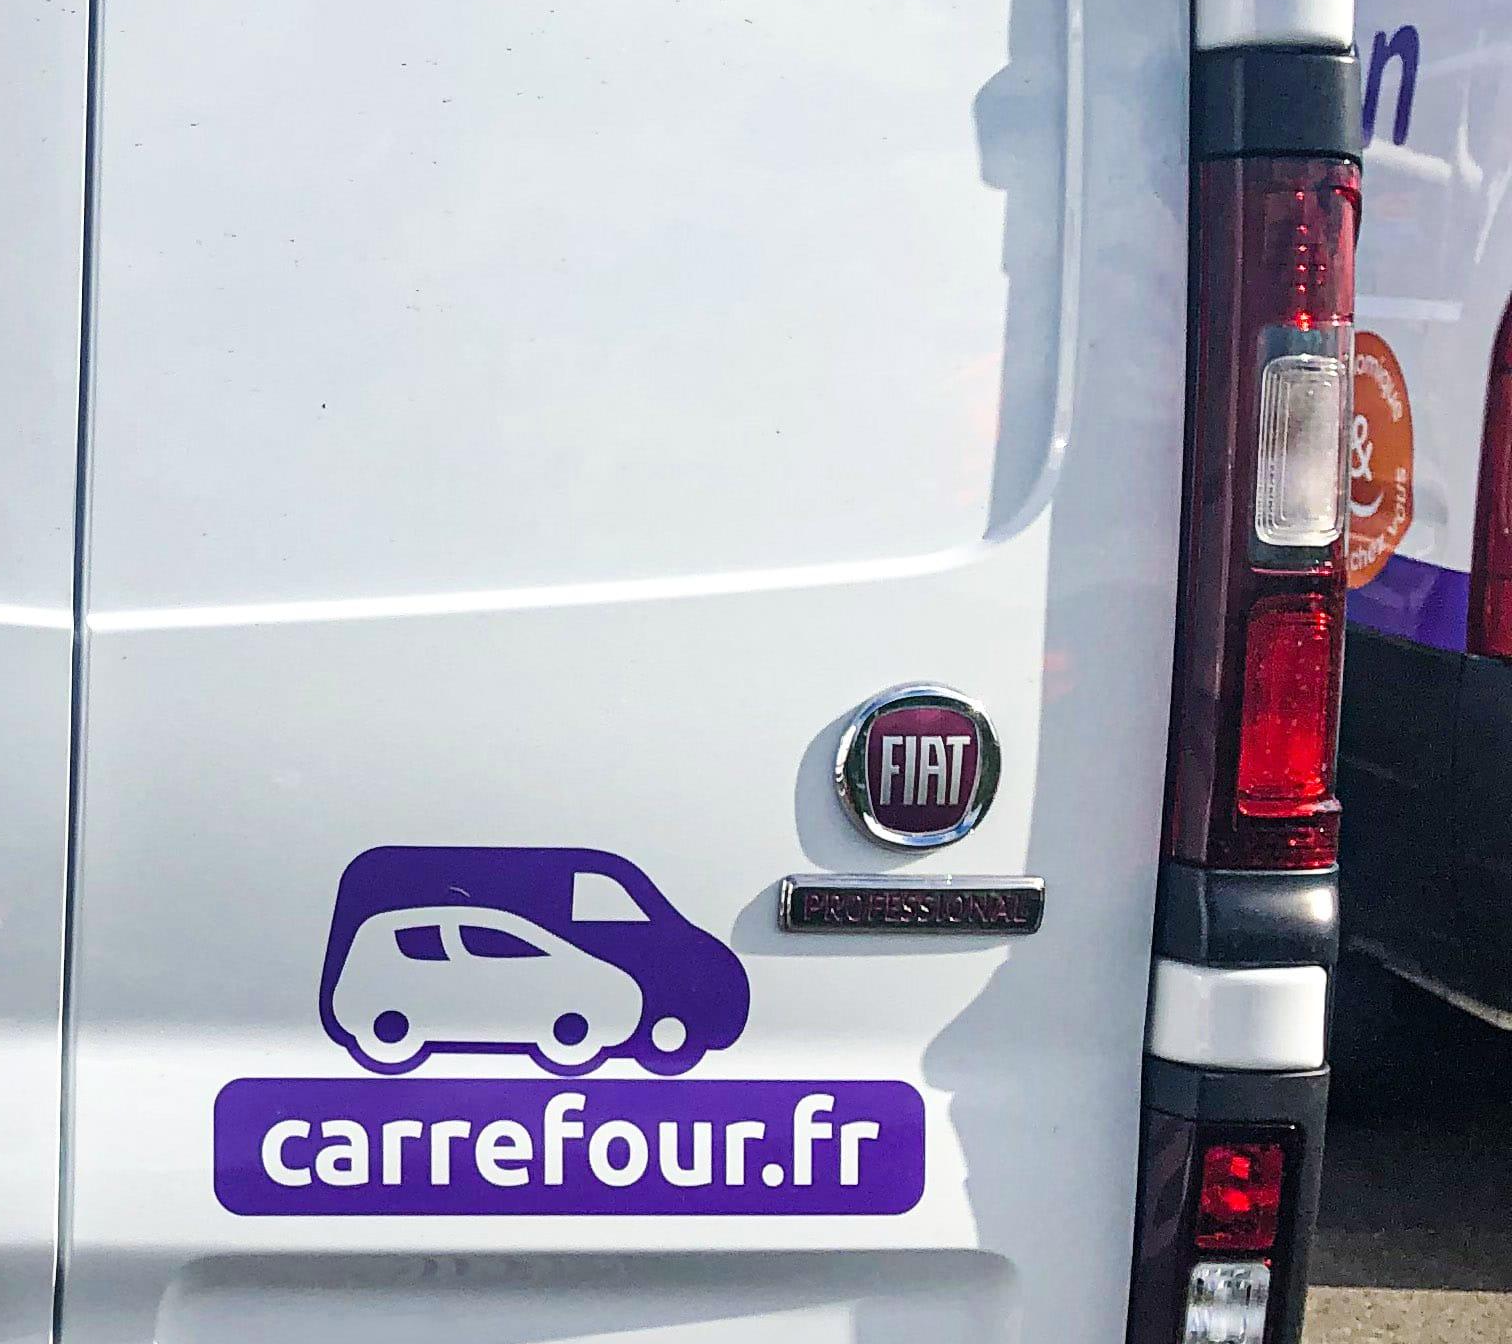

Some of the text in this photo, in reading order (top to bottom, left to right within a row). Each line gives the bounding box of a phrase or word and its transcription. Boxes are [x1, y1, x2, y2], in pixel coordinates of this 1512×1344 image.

[879, 735, 972, 806] FIAT
[803, 894, 1028, 924] PROFESSIONAL
[261, 1092, 880, 1188] carrefour.fr
